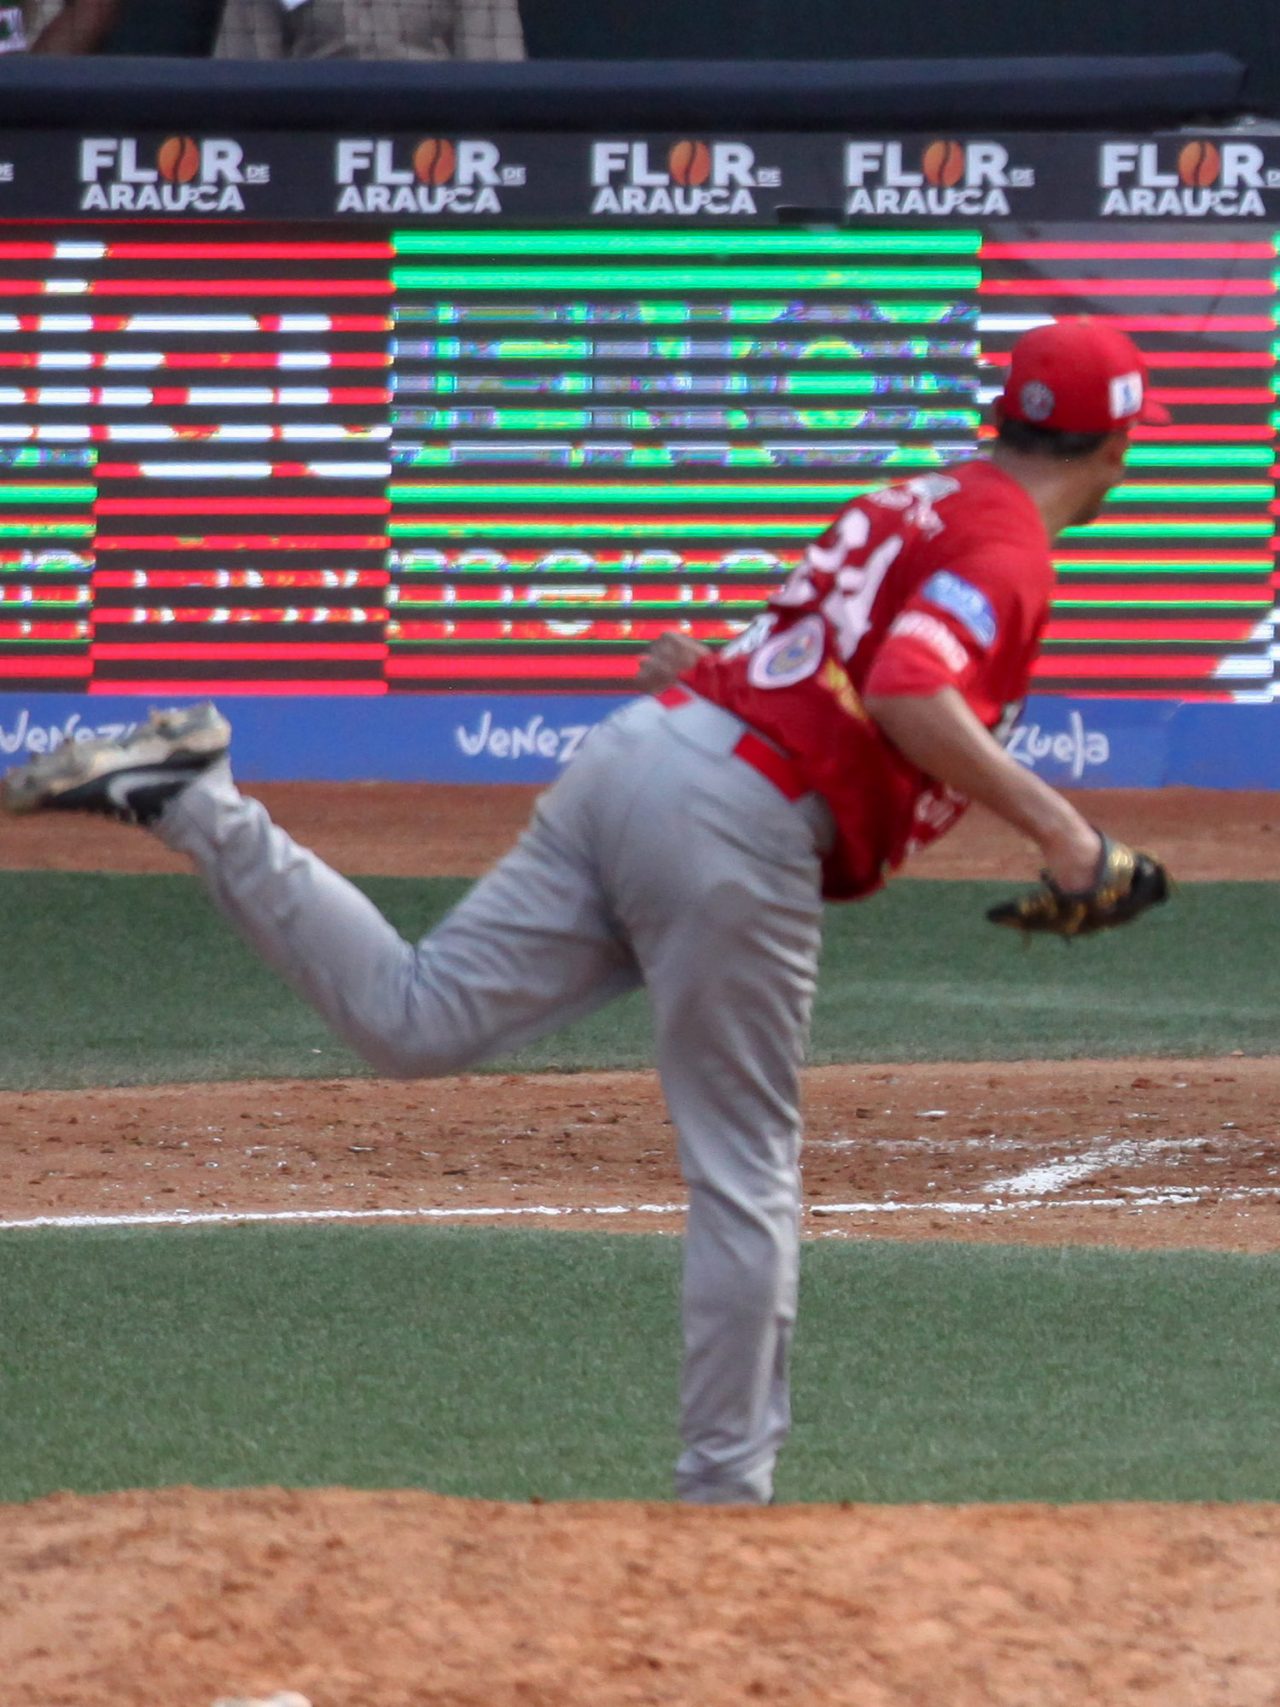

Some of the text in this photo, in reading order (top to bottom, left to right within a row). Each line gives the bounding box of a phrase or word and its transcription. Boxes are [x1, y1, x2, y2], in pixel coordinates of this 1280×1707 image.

[81, 137, 245, 183] FLOR
[337, 138, 501, 185] FLOR
[591, 140, 756, 186] FLOR
[845, 140, 1009, 186] FLOR
[1101, 141, 1265, 187] FLOR
[82, 186, 245, 212] ARAUCA
[338, 187, 501, 214] ARAUCA
[592, 189, 756, 215] ARAUCA
[846, 189, 1009, 216] ARAUCA
[1102, 190, 1265, 216] ARAUCA
